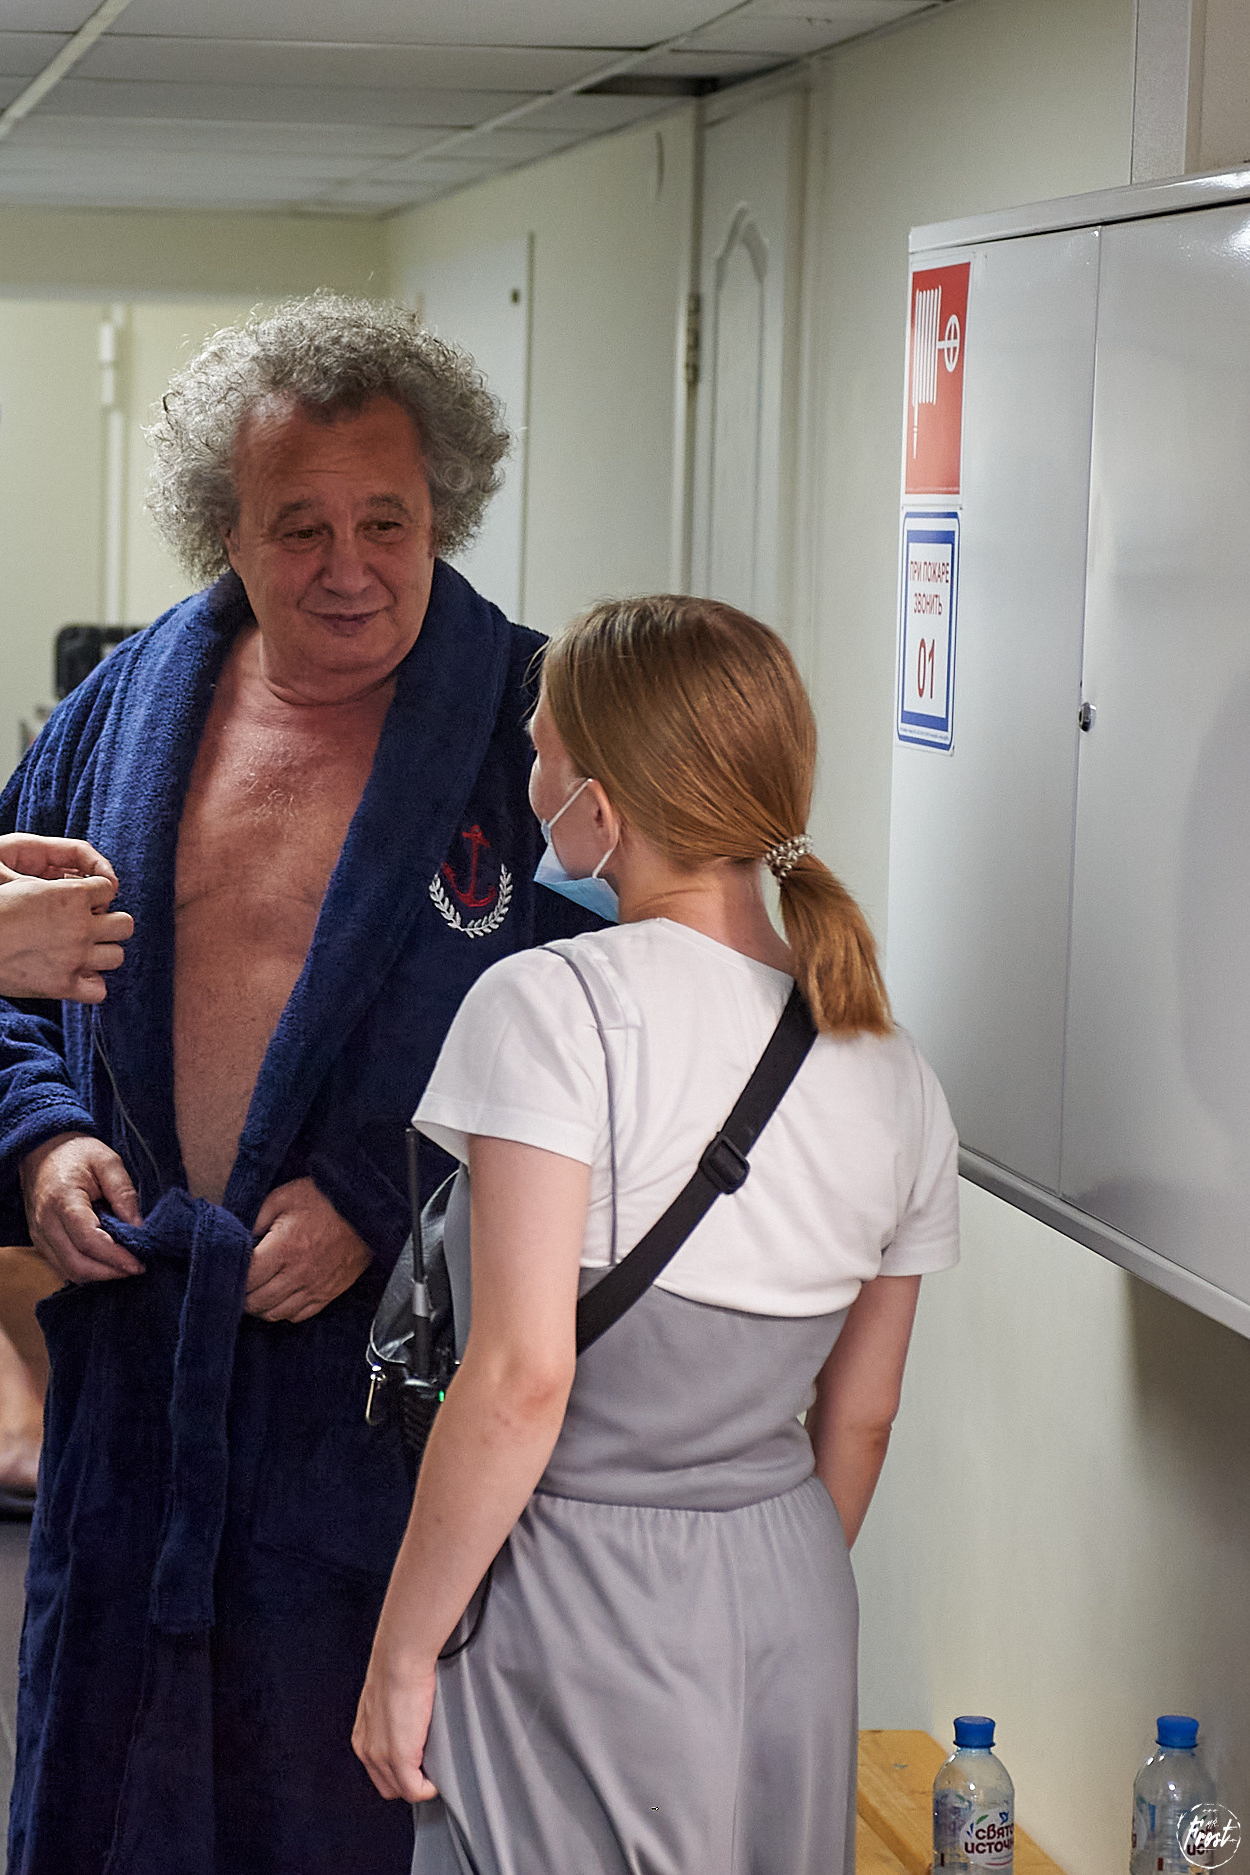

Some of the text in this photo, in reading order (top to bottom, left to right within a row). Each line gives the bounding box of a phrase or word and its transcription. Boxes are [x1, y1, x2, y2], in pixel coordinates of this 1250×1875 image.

[910, 561, 949, 583] ПРИ ПОЖАРЕ
[914, 593, 942, 615] ЗВОНИТЬ
[917, 638, 935, 699] 01
